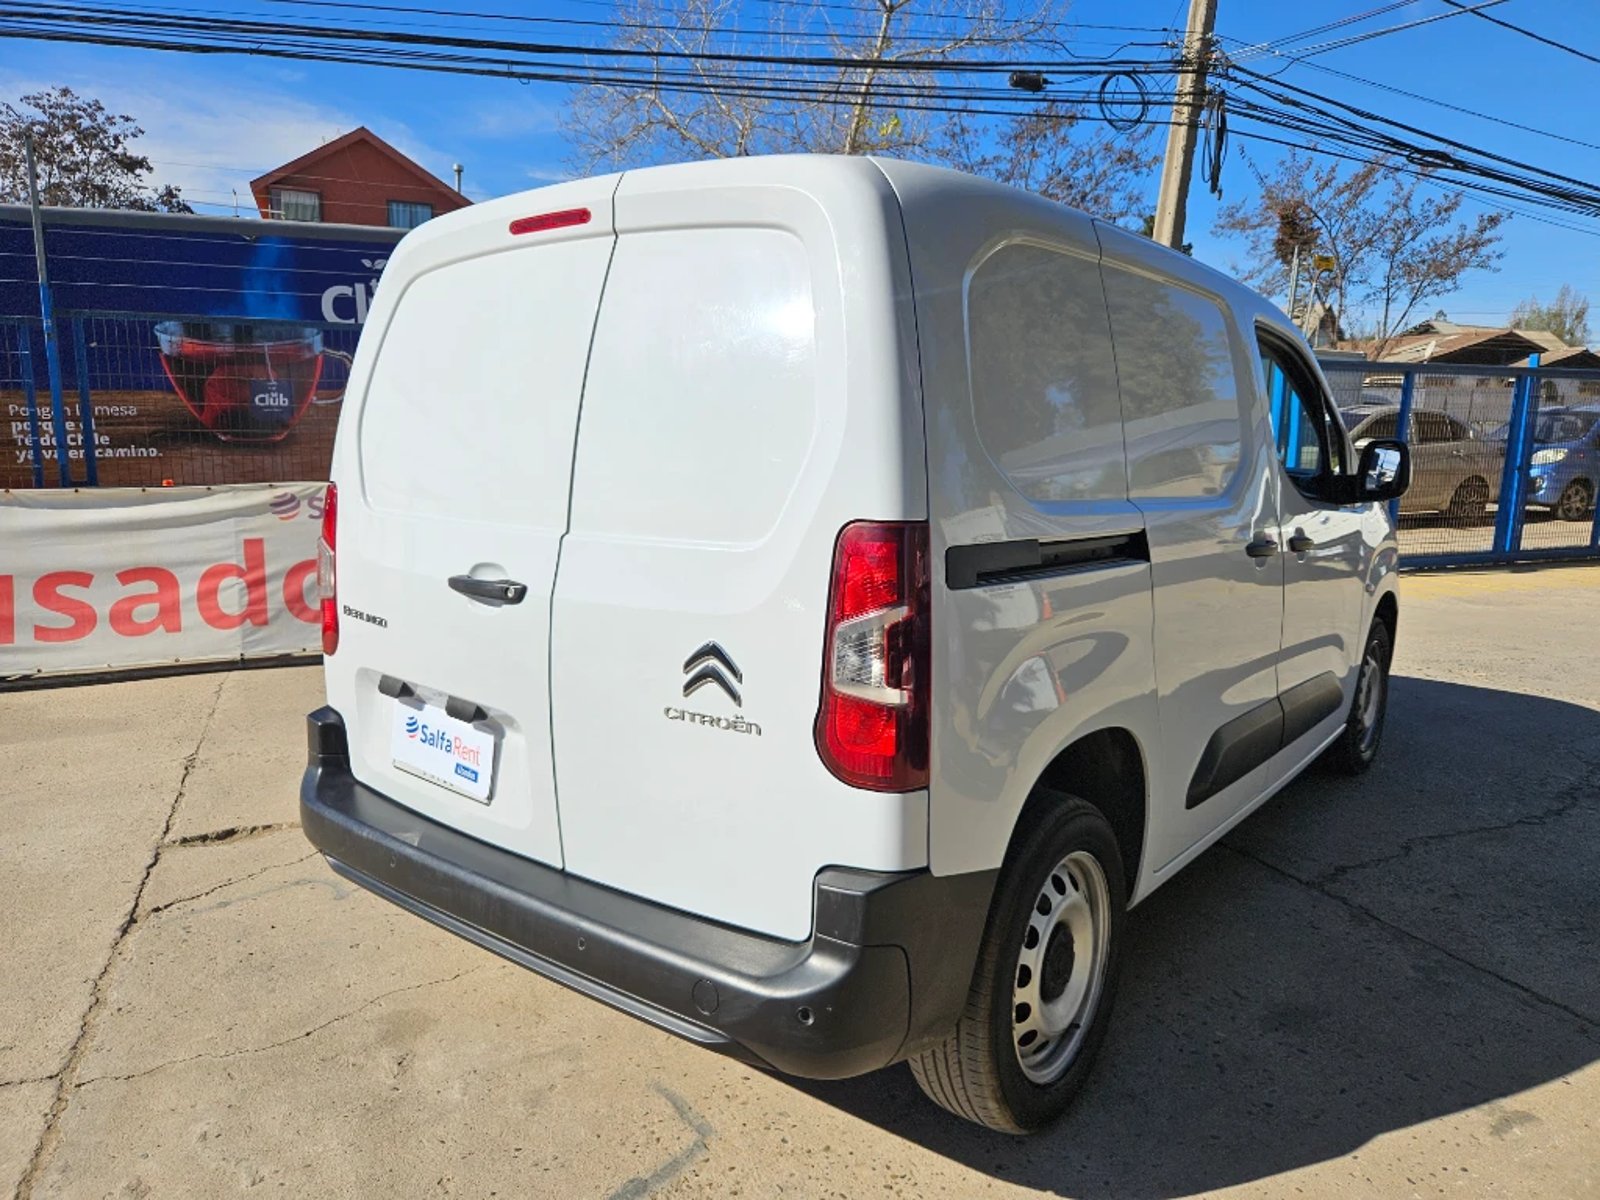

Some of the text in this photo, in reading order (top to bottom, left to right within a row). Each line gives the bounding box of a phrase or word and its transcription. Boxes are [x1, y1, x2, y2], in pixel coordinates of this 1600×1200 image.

[321, 283, 374, 324] Cl
[8, 403, 71, 419] Pogn
[94, 405, 138, 417] mesa
[11, 420, 76, 435] poqe
[66, 433, 111, 446] Chle
[94, 445, 163, 457] camino.
